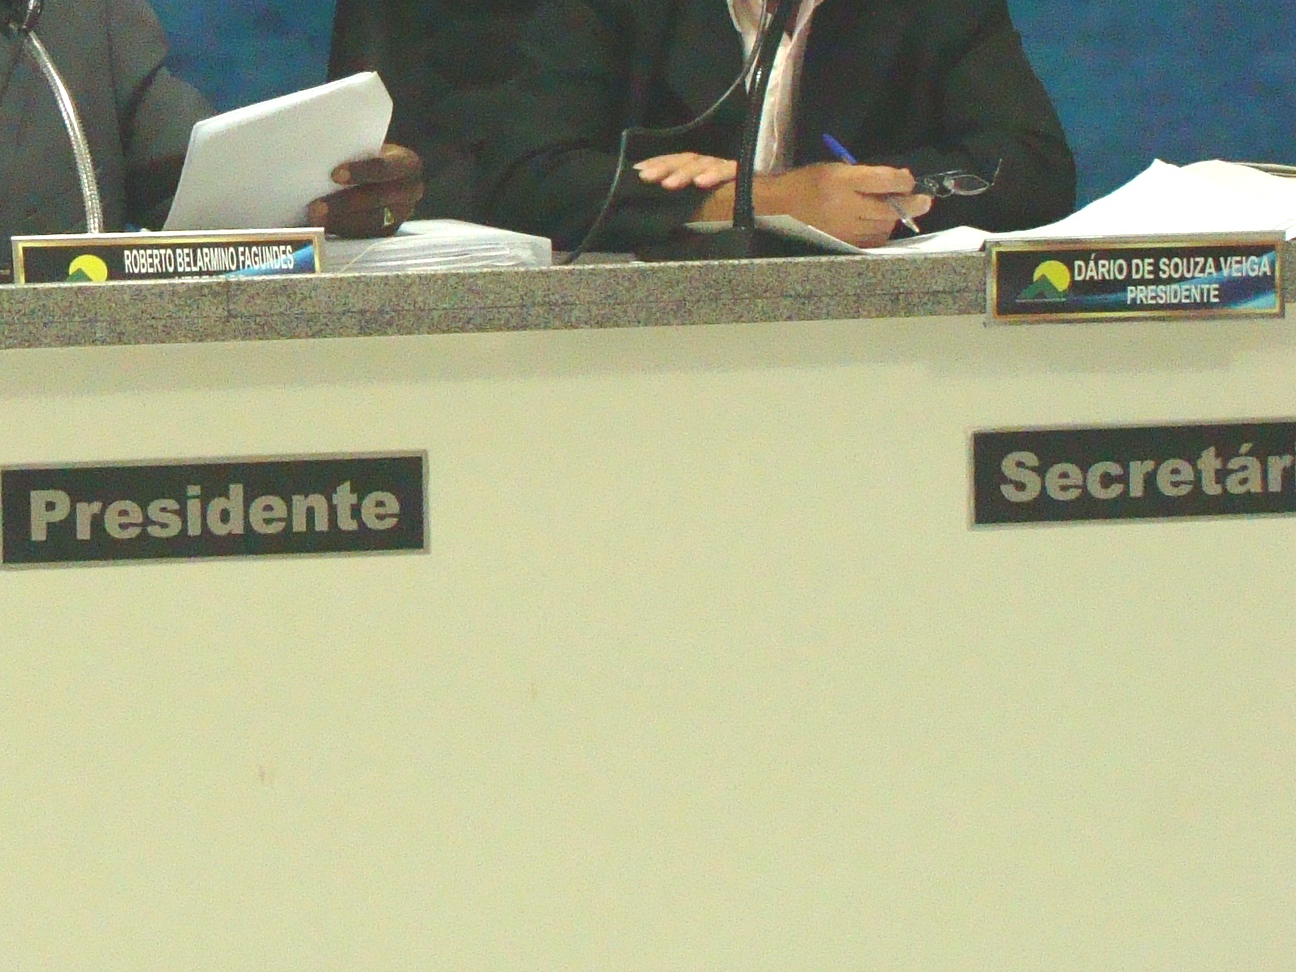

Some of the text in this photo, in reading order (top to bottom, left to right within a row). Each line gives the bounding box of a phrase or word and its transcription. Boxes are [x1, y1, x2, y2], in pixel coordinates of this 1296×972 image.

[124, 244, 294, 273] ROBERTO BELARMINO FAGUNDES
[1074, 253, 1272, 281] DÁRIO DE SOUZA VEIGA
[1127, 284, 1220, 305] PRESIDENTE
[1000, 443, 1296, 503] Secretár
[29, 480, 401, 542] Presidente
